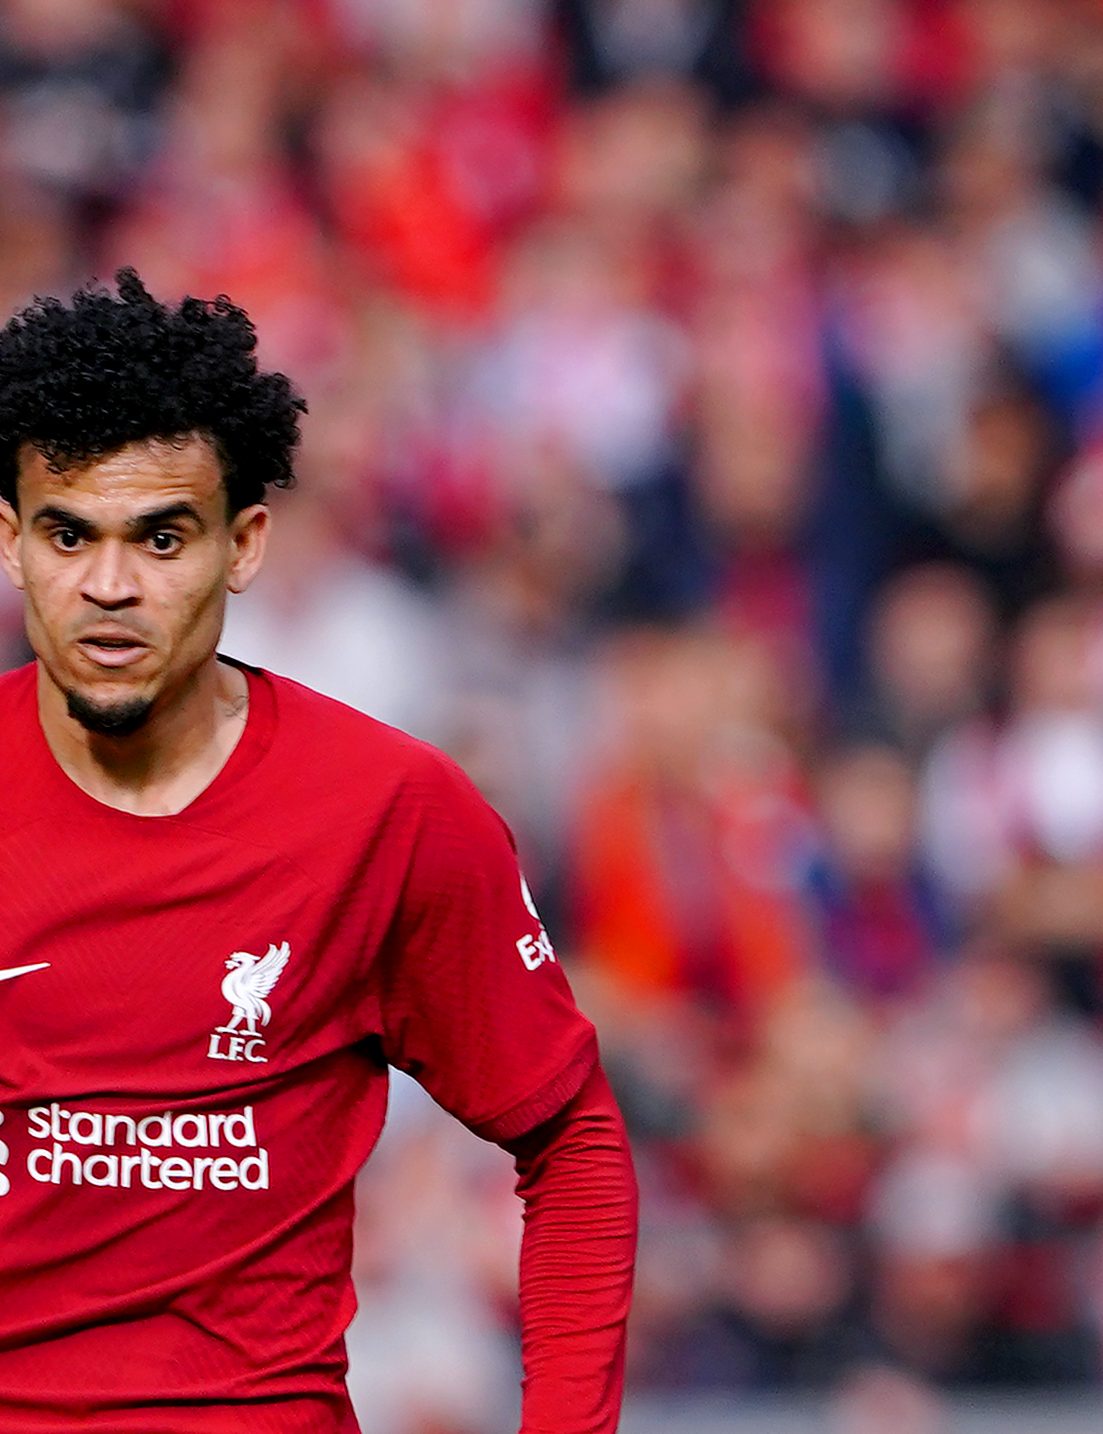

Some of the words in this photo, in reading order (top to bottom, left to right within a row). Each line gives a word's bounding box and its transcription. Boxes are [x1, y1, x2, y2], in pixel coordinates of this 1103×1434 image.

[207, 1034, 269, 1063] LFC
[27, 1102, 258, 1149] standard
[26, 1142, 270, 1191] chartered
